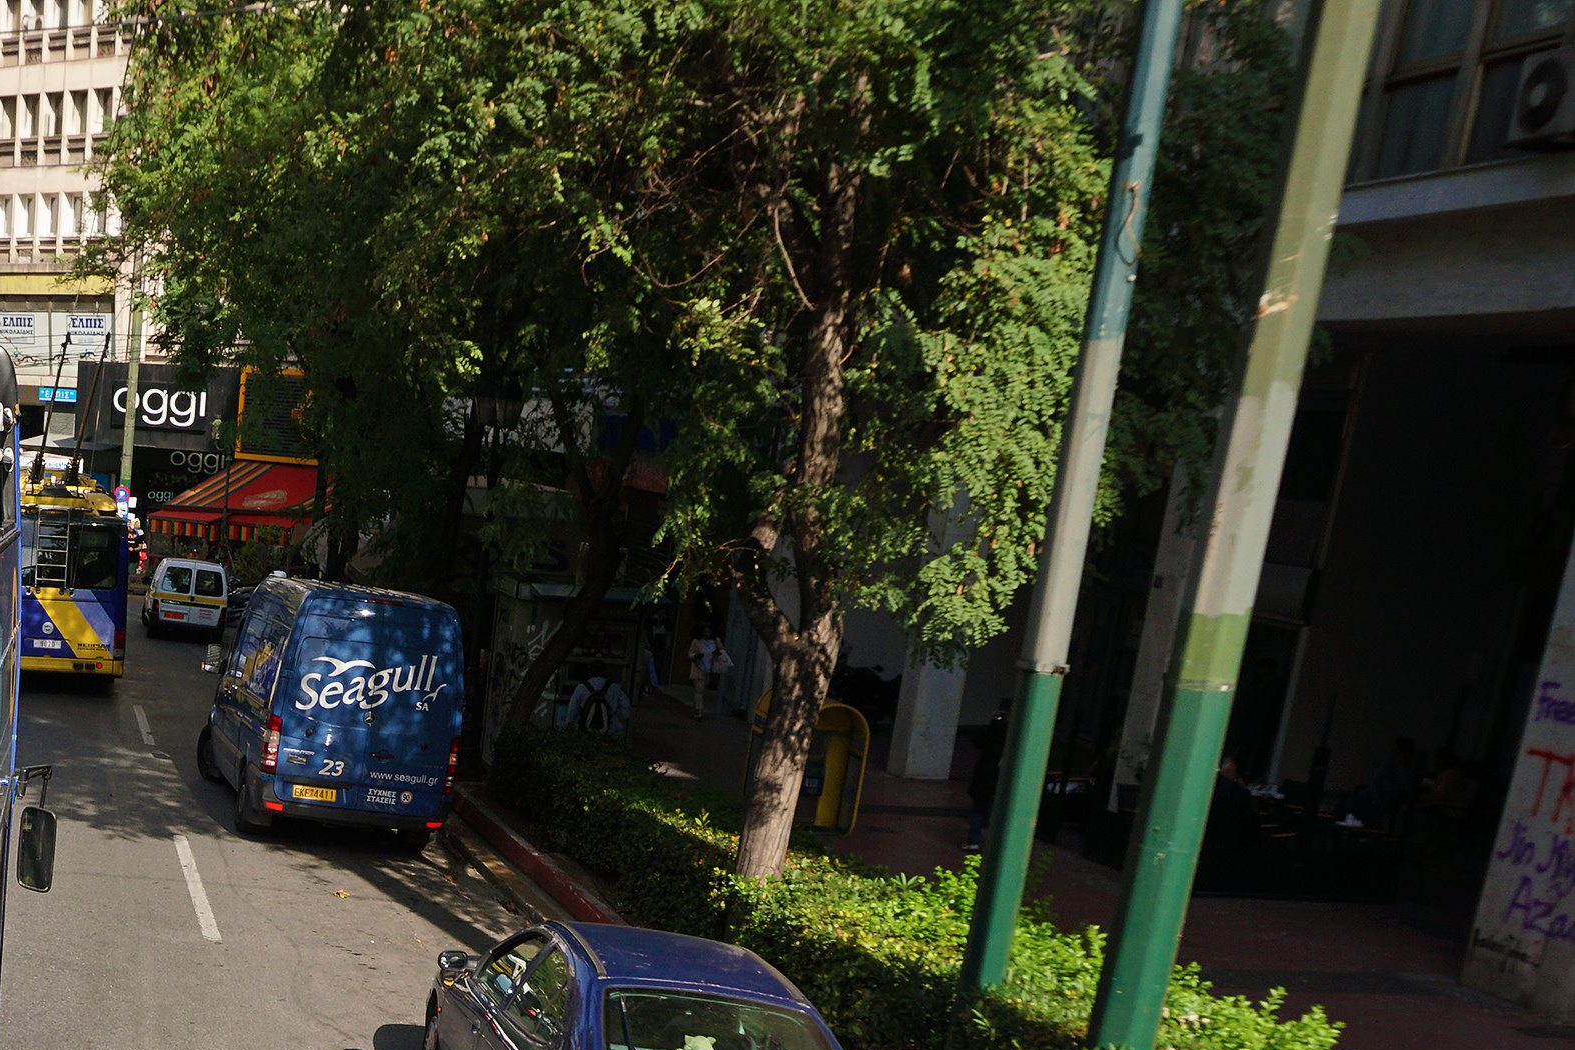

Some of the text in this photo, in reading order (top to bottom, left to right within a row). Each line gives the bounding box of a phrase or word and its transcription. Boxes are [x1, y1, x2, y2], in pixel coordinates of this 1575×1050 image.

[2, 317, 33, 327] ΕΛΠΙΣ
[71, 318, 104, 328] ΕΛΠΙΣ
[113, 387, 207, 427] oggi
[170, 451, 225, 474] oggi
[295, 654, 438, 711] Seagull
[415, 701, 429, 712] SA
[318, 759, 345, 777] 23
[370, 771, 438, 787] www.seagull.gr
